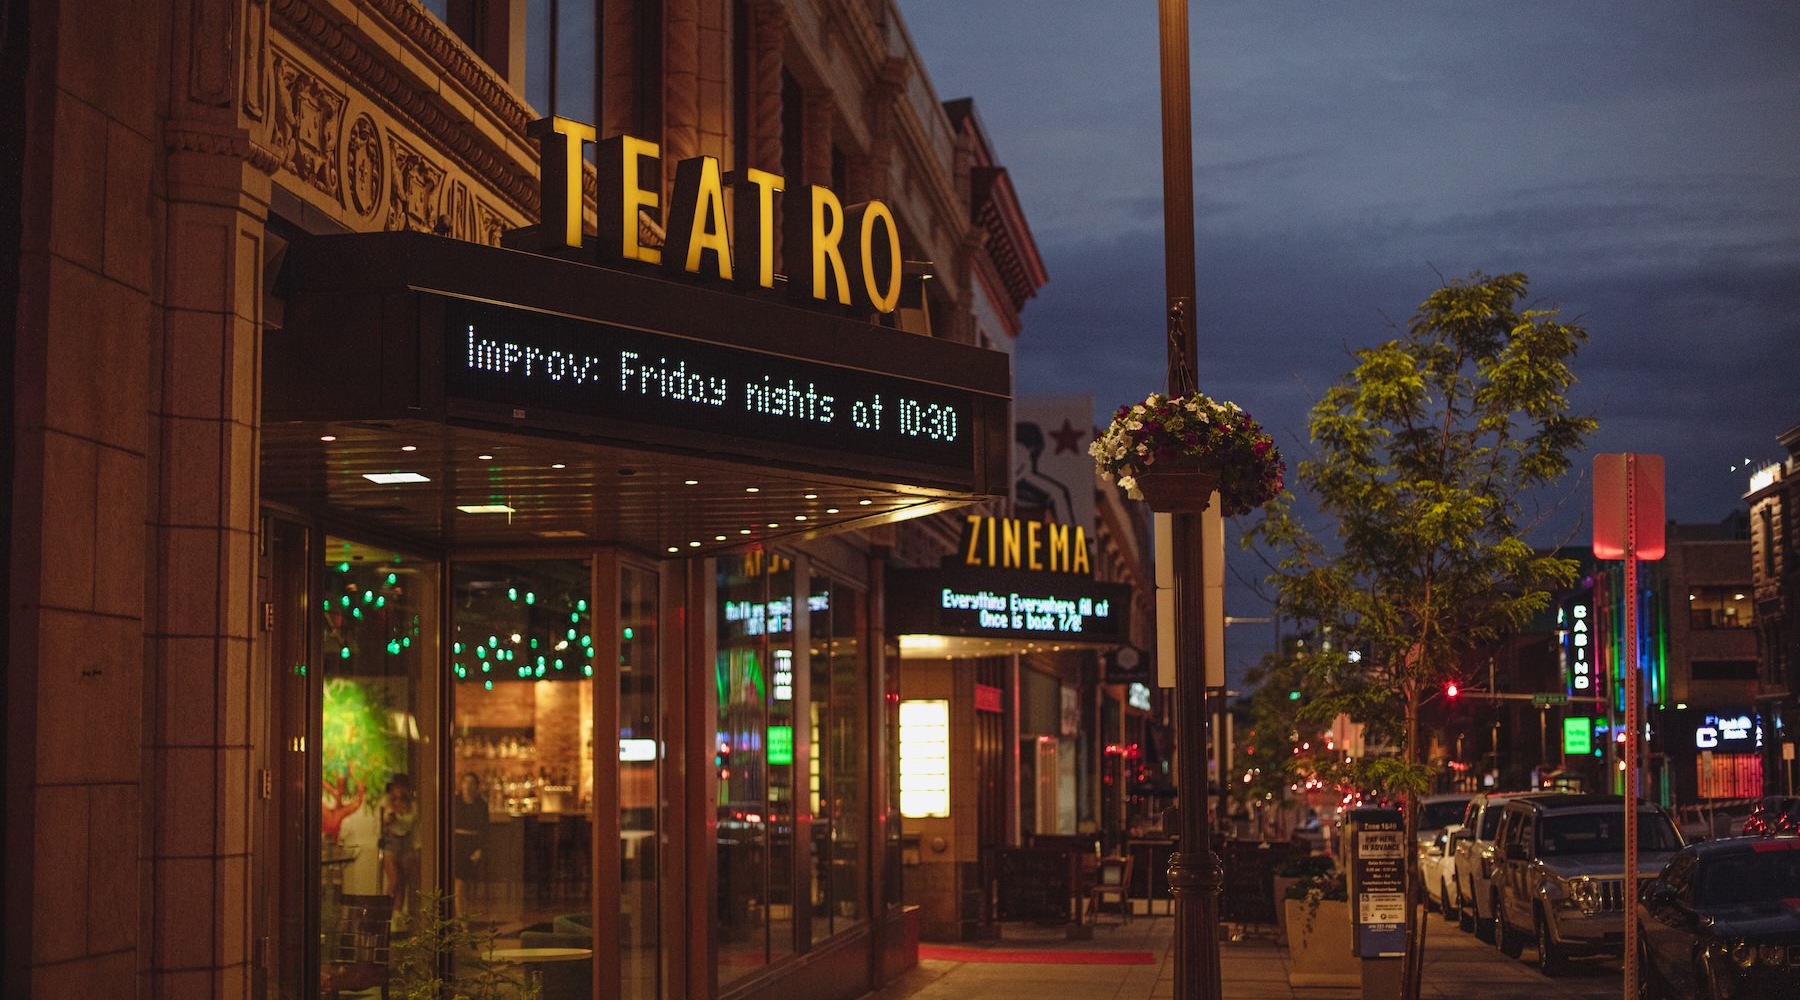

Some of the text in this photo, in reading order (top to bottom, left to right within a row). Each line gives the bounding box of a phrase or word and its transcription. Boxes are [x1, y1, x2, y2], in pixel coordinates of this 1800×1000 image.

[552, 115, 901, 315] TEATRO
[467, 324, 959, 443] Improv: Friday nights at 10:30
[966, 514, 1090, 574] ZINEMA
[941, 588, 1109, 617] Everything Everywhere All at
[980, 609, 1009, 628] Once
[1012, 611, 1023, 629] is
[1026, 611, 1055, 630] back
[1362, 843, 1401, 851] IN ADVANCE
